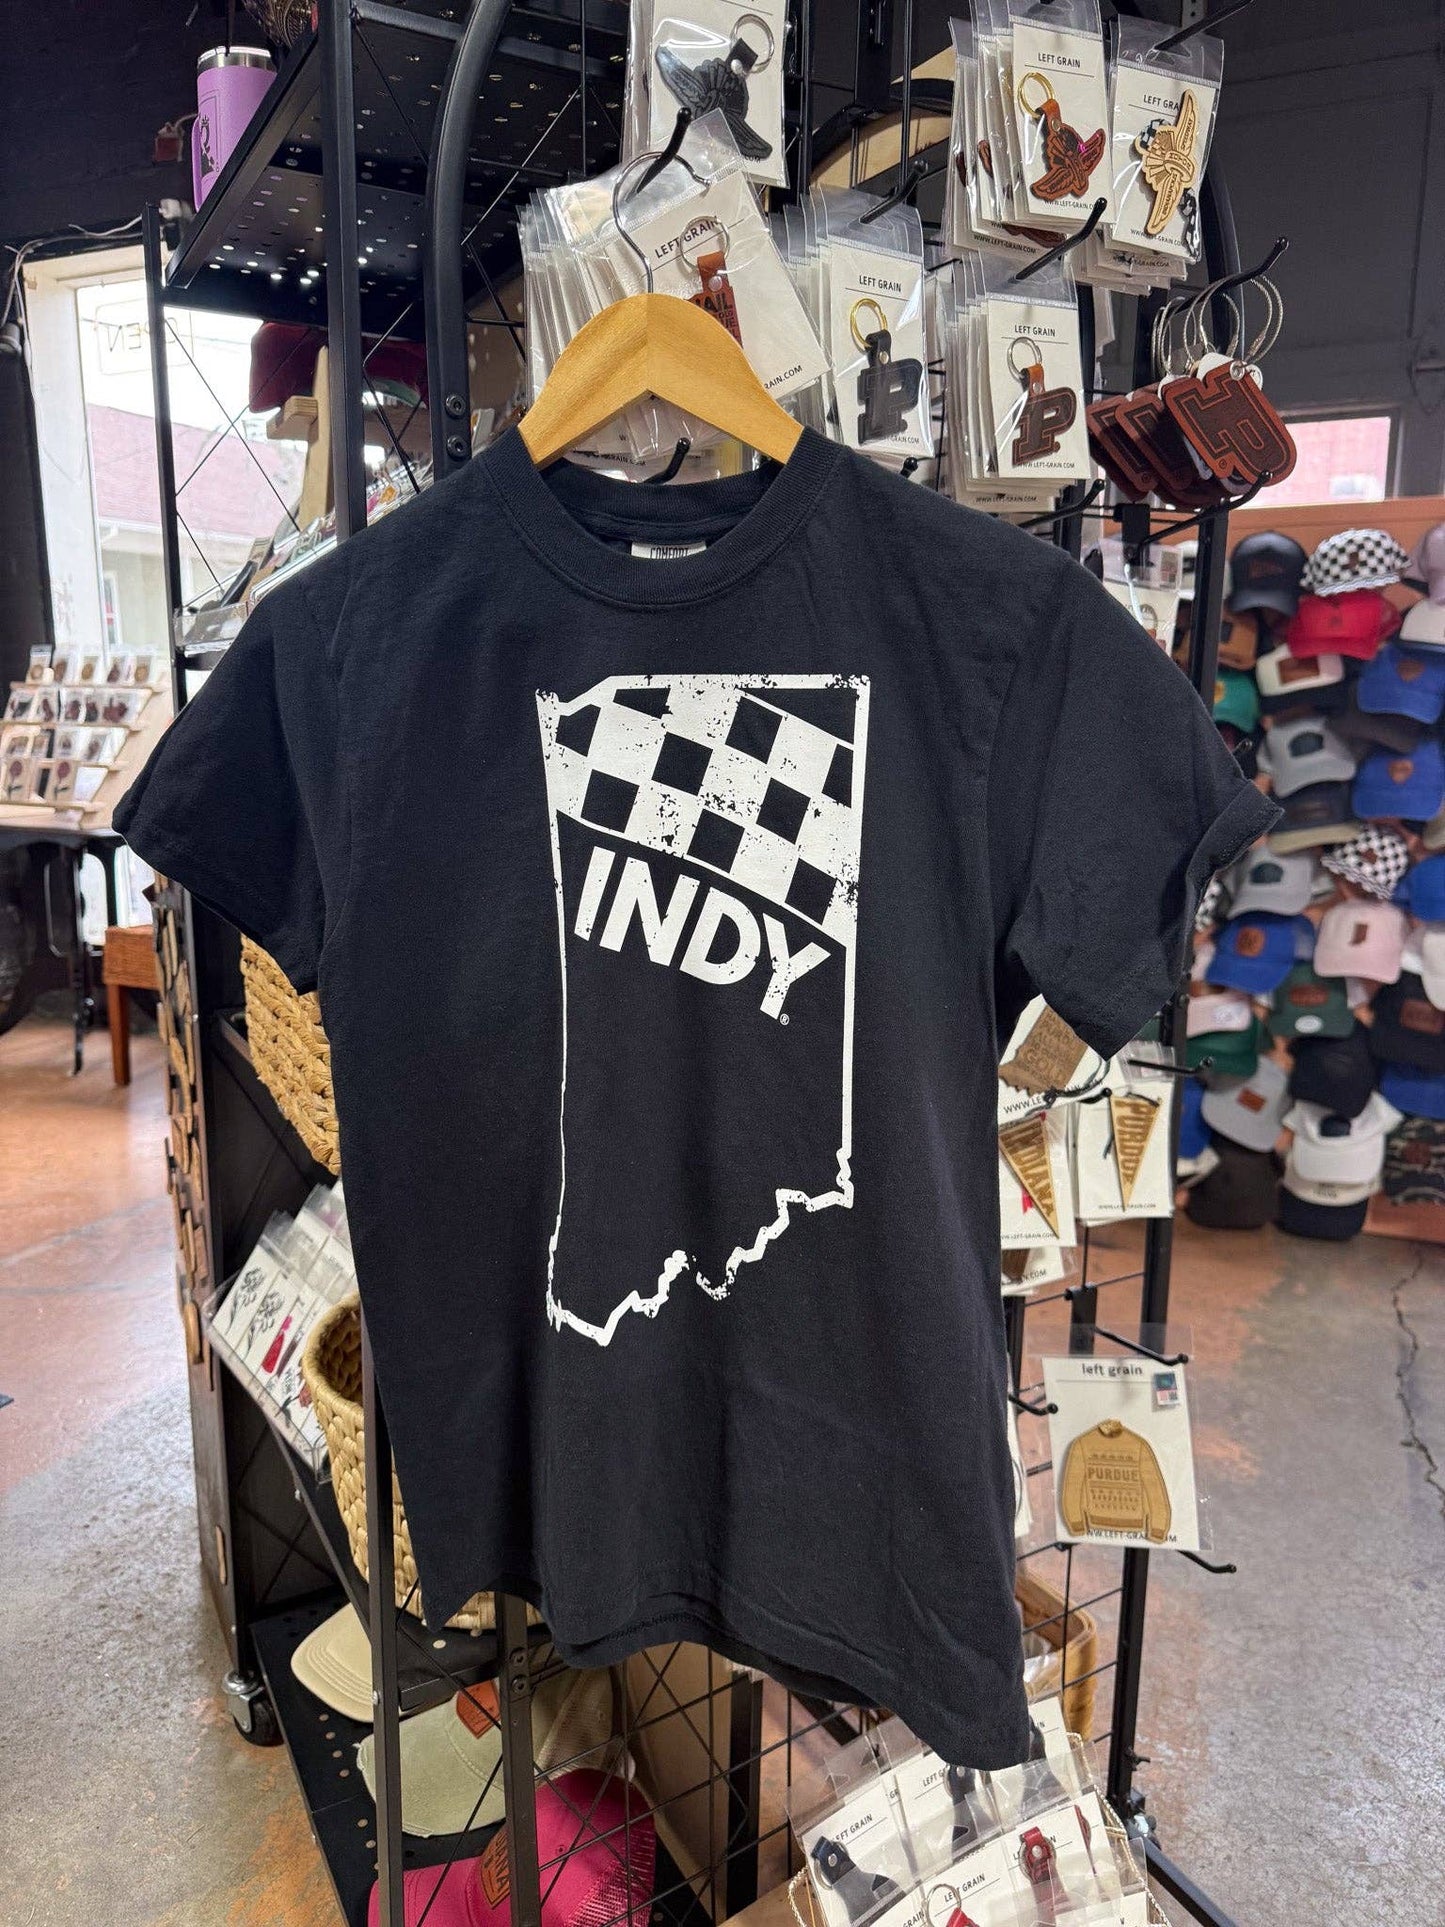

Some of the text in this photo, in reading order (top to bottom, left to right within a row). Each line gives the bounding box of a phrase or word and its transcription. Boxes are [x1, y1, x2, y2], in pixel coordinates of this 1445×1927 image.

[1037, 53, 1081, 69] LEFT GRAIN
[1143, 94, 1180, 112] LEFT GRA
[858, 274, 902, 293] LEFT GRAIN
[1014, 324, 1056, 338] LEFT GRAIN
[574, 845, 832, 1020] INDY
[1082, 1363, 1143, 1378] left grain
[1087, 1467, 1139, 1481] PURDUE
[922, 1771, 938, 1787] LEFT
[849, 1813, 874, 1834] GRAIN
[943, 1872, 986, 1903] LET GRAIN
